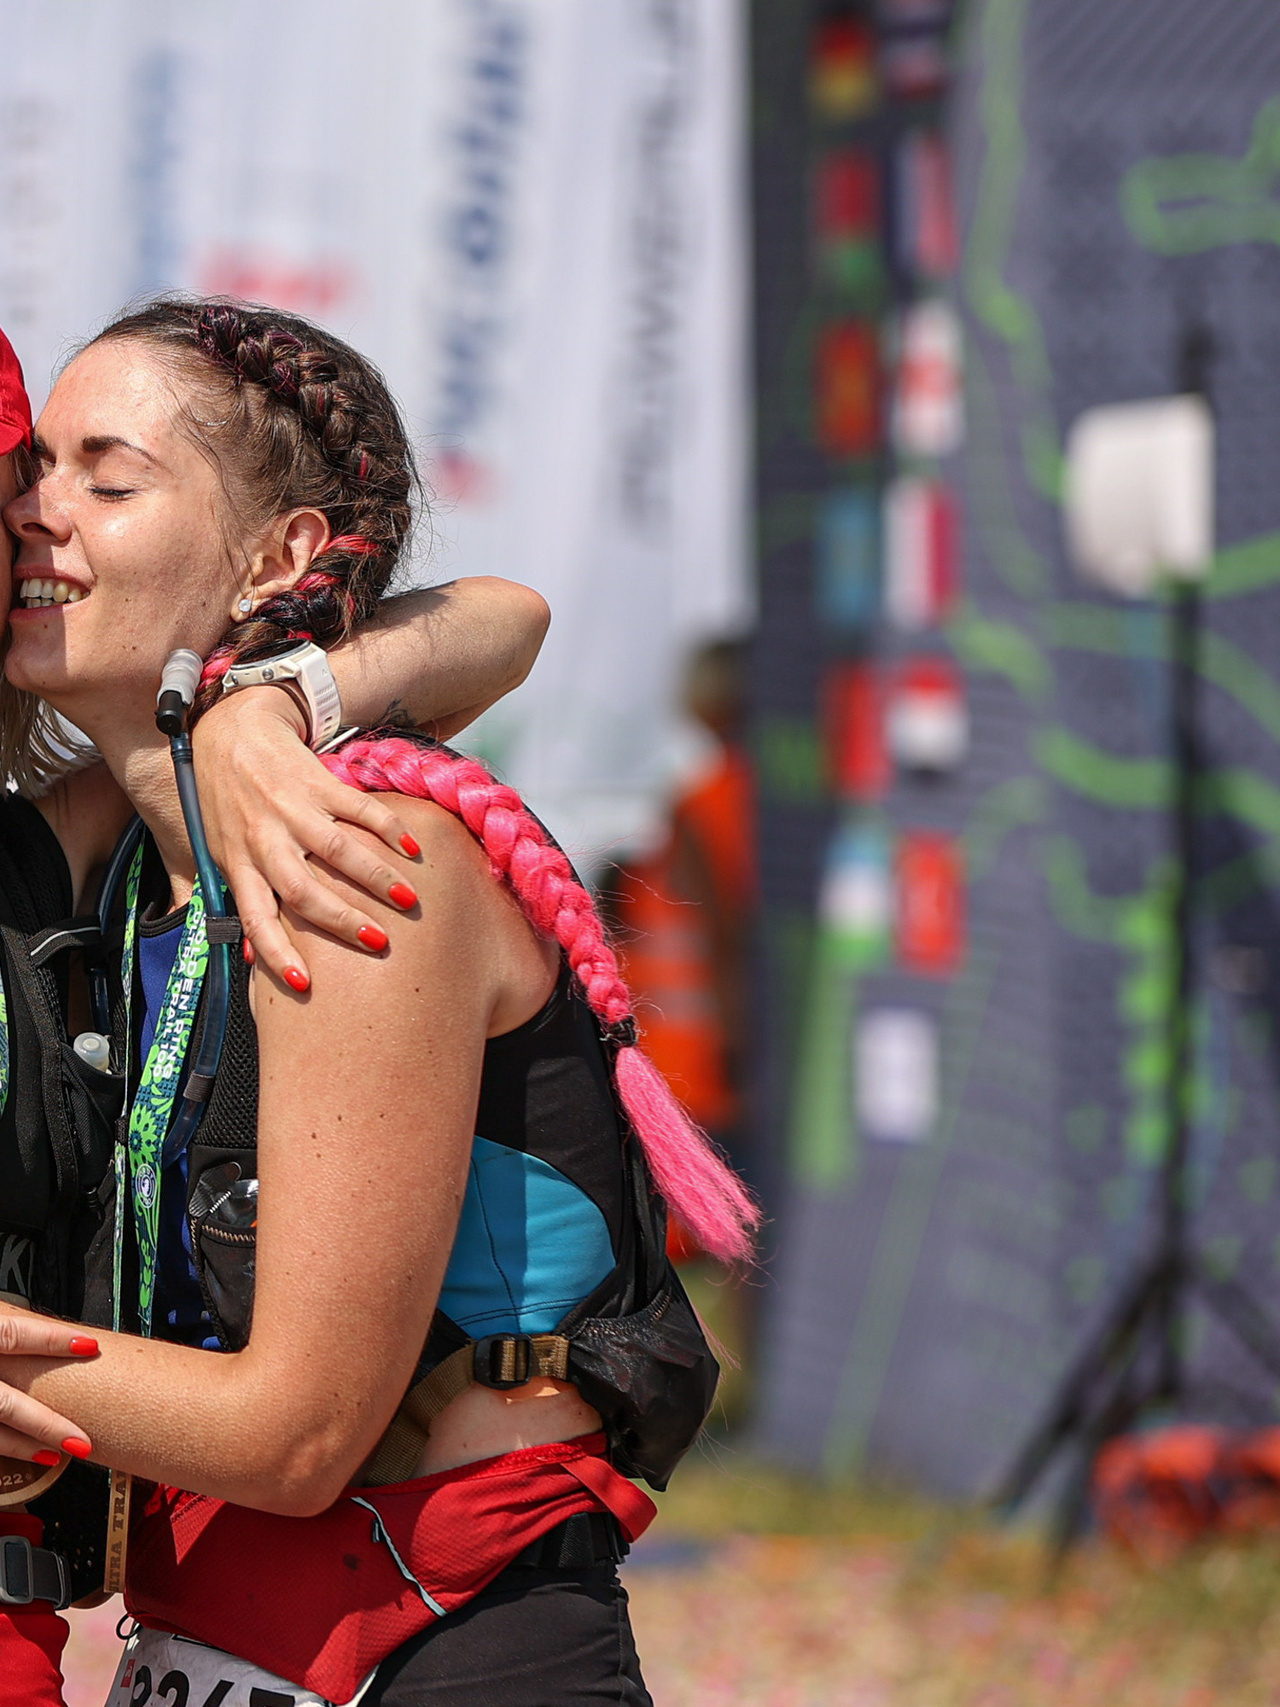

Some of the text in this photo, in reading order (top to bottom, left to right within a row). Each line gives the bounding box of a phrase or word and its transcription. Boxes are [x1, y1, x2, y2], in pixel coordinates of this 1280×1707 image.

[153, 911, 202, 1078] ULTRA TRAIL 100
[162, 1019, 184, 1079] RING
